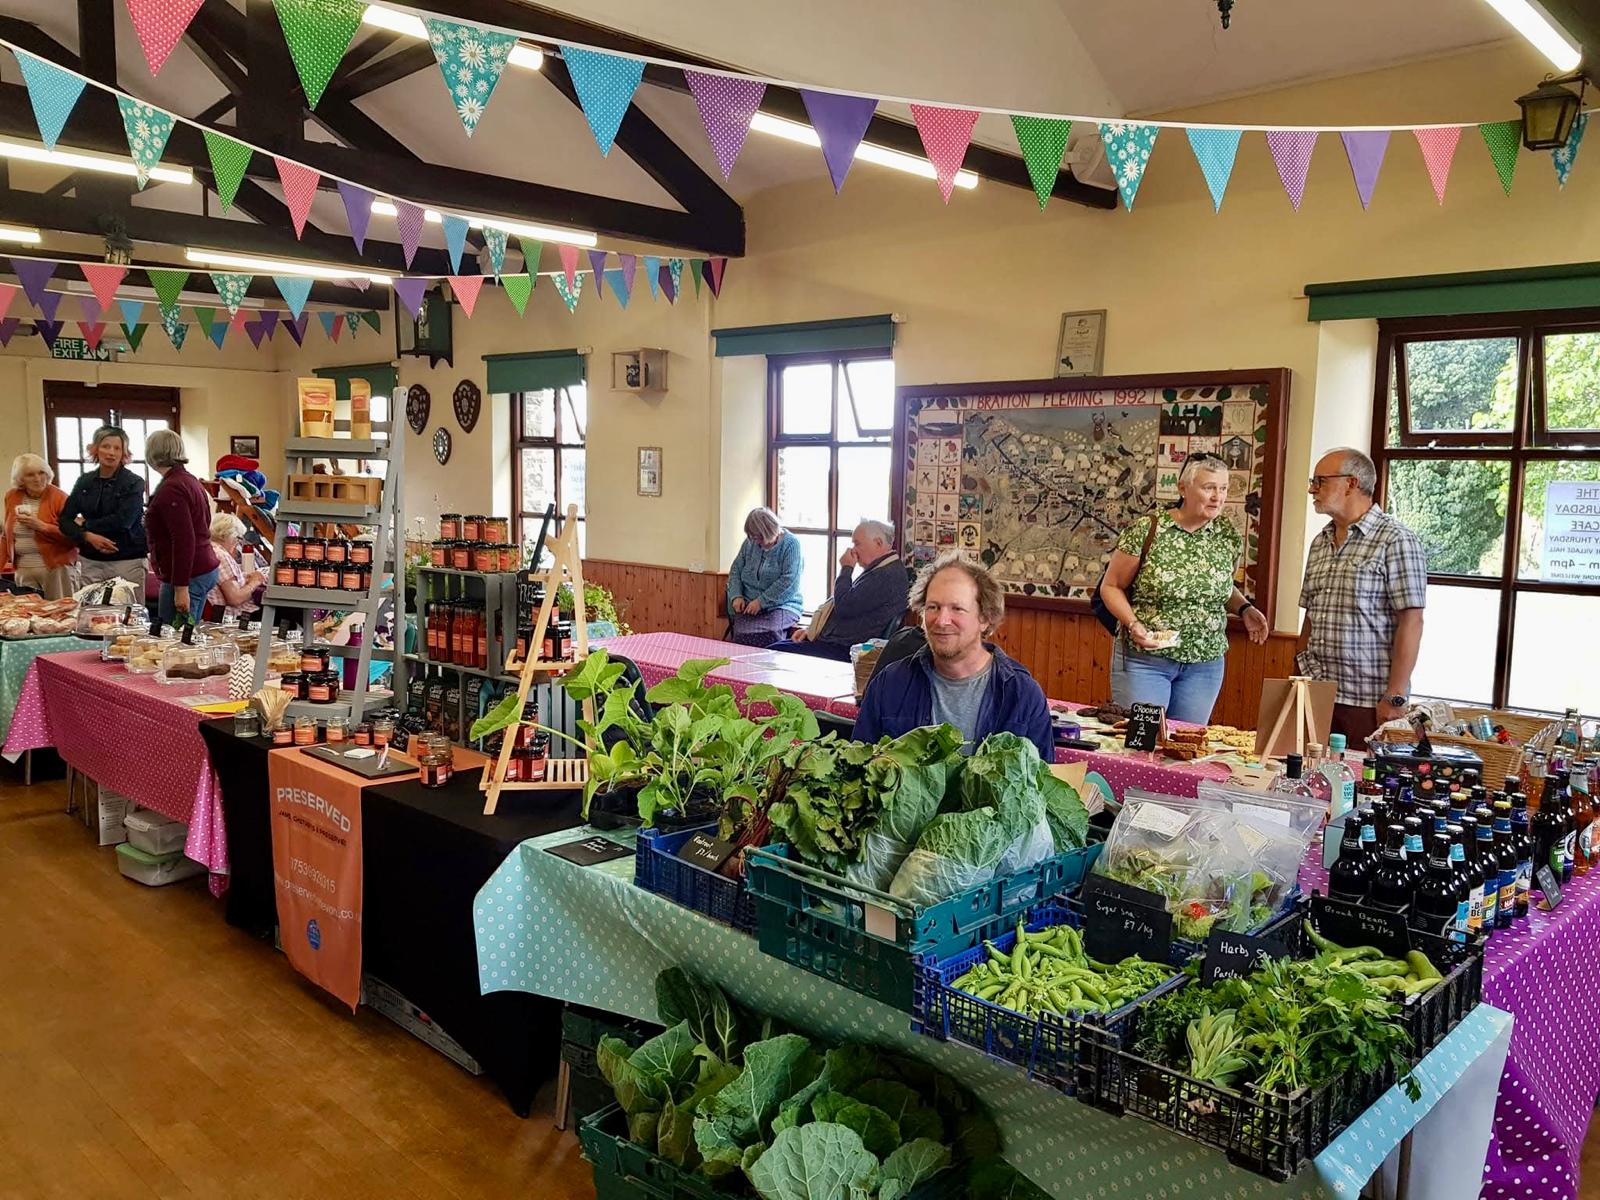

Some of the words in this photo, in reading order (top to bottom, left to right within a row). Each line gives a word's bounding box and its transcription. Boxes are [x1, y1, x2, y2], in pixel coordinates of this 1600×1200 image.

[53, 338, 79, 349] FIRE
[53, 348, 80, 359] EXIT
[977, 394, 1031, 410] BRATTON
[1043, 391, 1103, 407] FLEMING
[1114, 389, 1147, 405] 1992
[276, 787, 351, 832] PRESERVED
